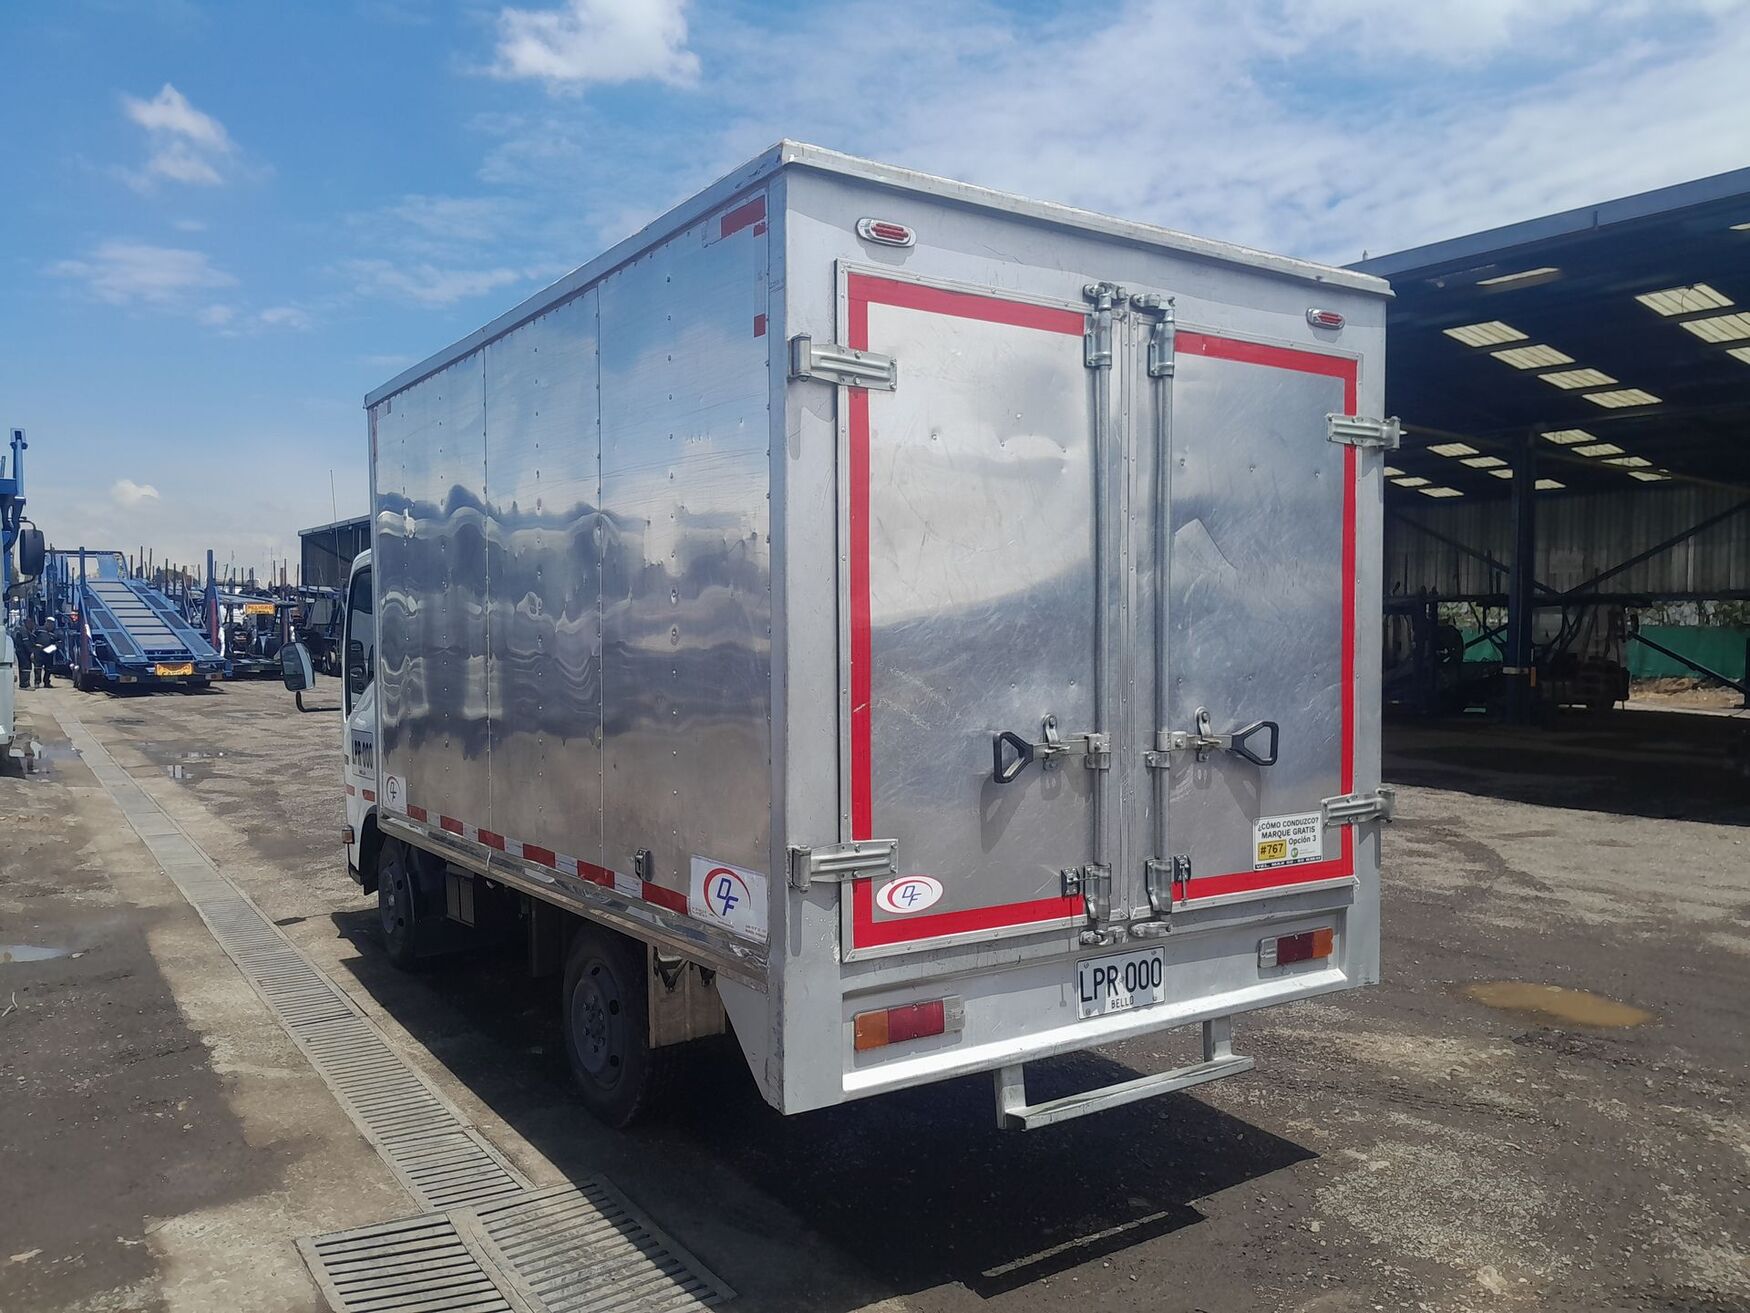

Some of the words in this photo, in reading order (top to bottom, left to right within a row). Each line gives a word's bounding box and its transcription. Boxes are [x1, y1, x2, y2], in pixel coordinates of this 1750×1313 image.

[1258, 821, 1281, 832] ¿CÓMO
[1282, 817, 1319, 828] CONDUZCO?
[1261, 828, 1291, 839] MARQUE
[1292, 826, 1316, 836] GRATIS
[1288, 836, 1311, 845] Opción
[1260, 843, 1284, 855] #767
[1080, 965, 1119, 1003] LPR
[1125, 957, 1162, 993] 000
[1111, 995, 1135, 1009] BELLO
